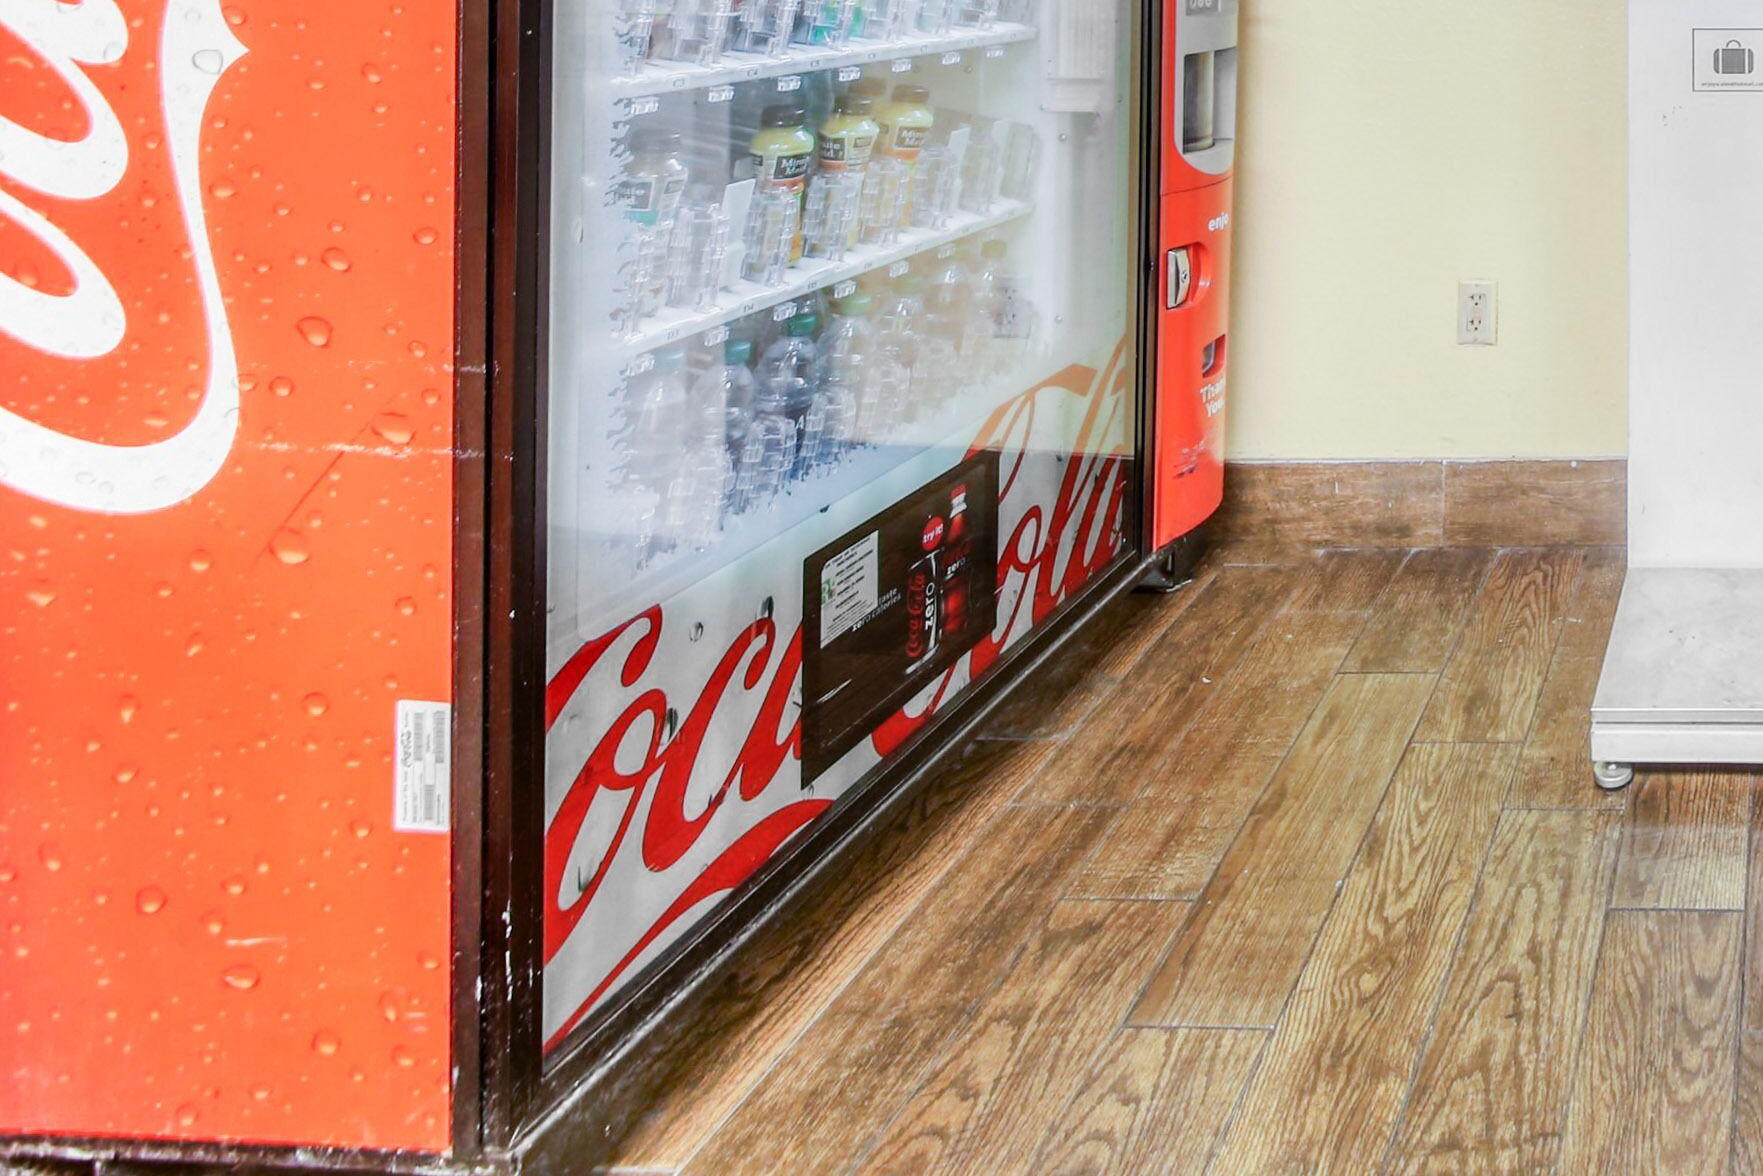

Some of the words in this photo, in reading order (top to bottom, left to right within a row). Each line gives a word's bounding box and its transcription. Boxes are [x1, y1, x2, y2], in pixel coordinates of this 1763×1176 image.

[1208, 213, 1230, 232] enjo
[923, 530, 936, 543] try
[946, 557, 967, 575] zero
[925, 582, 936, 631] zero
[852, 614, 871, 632] zero
